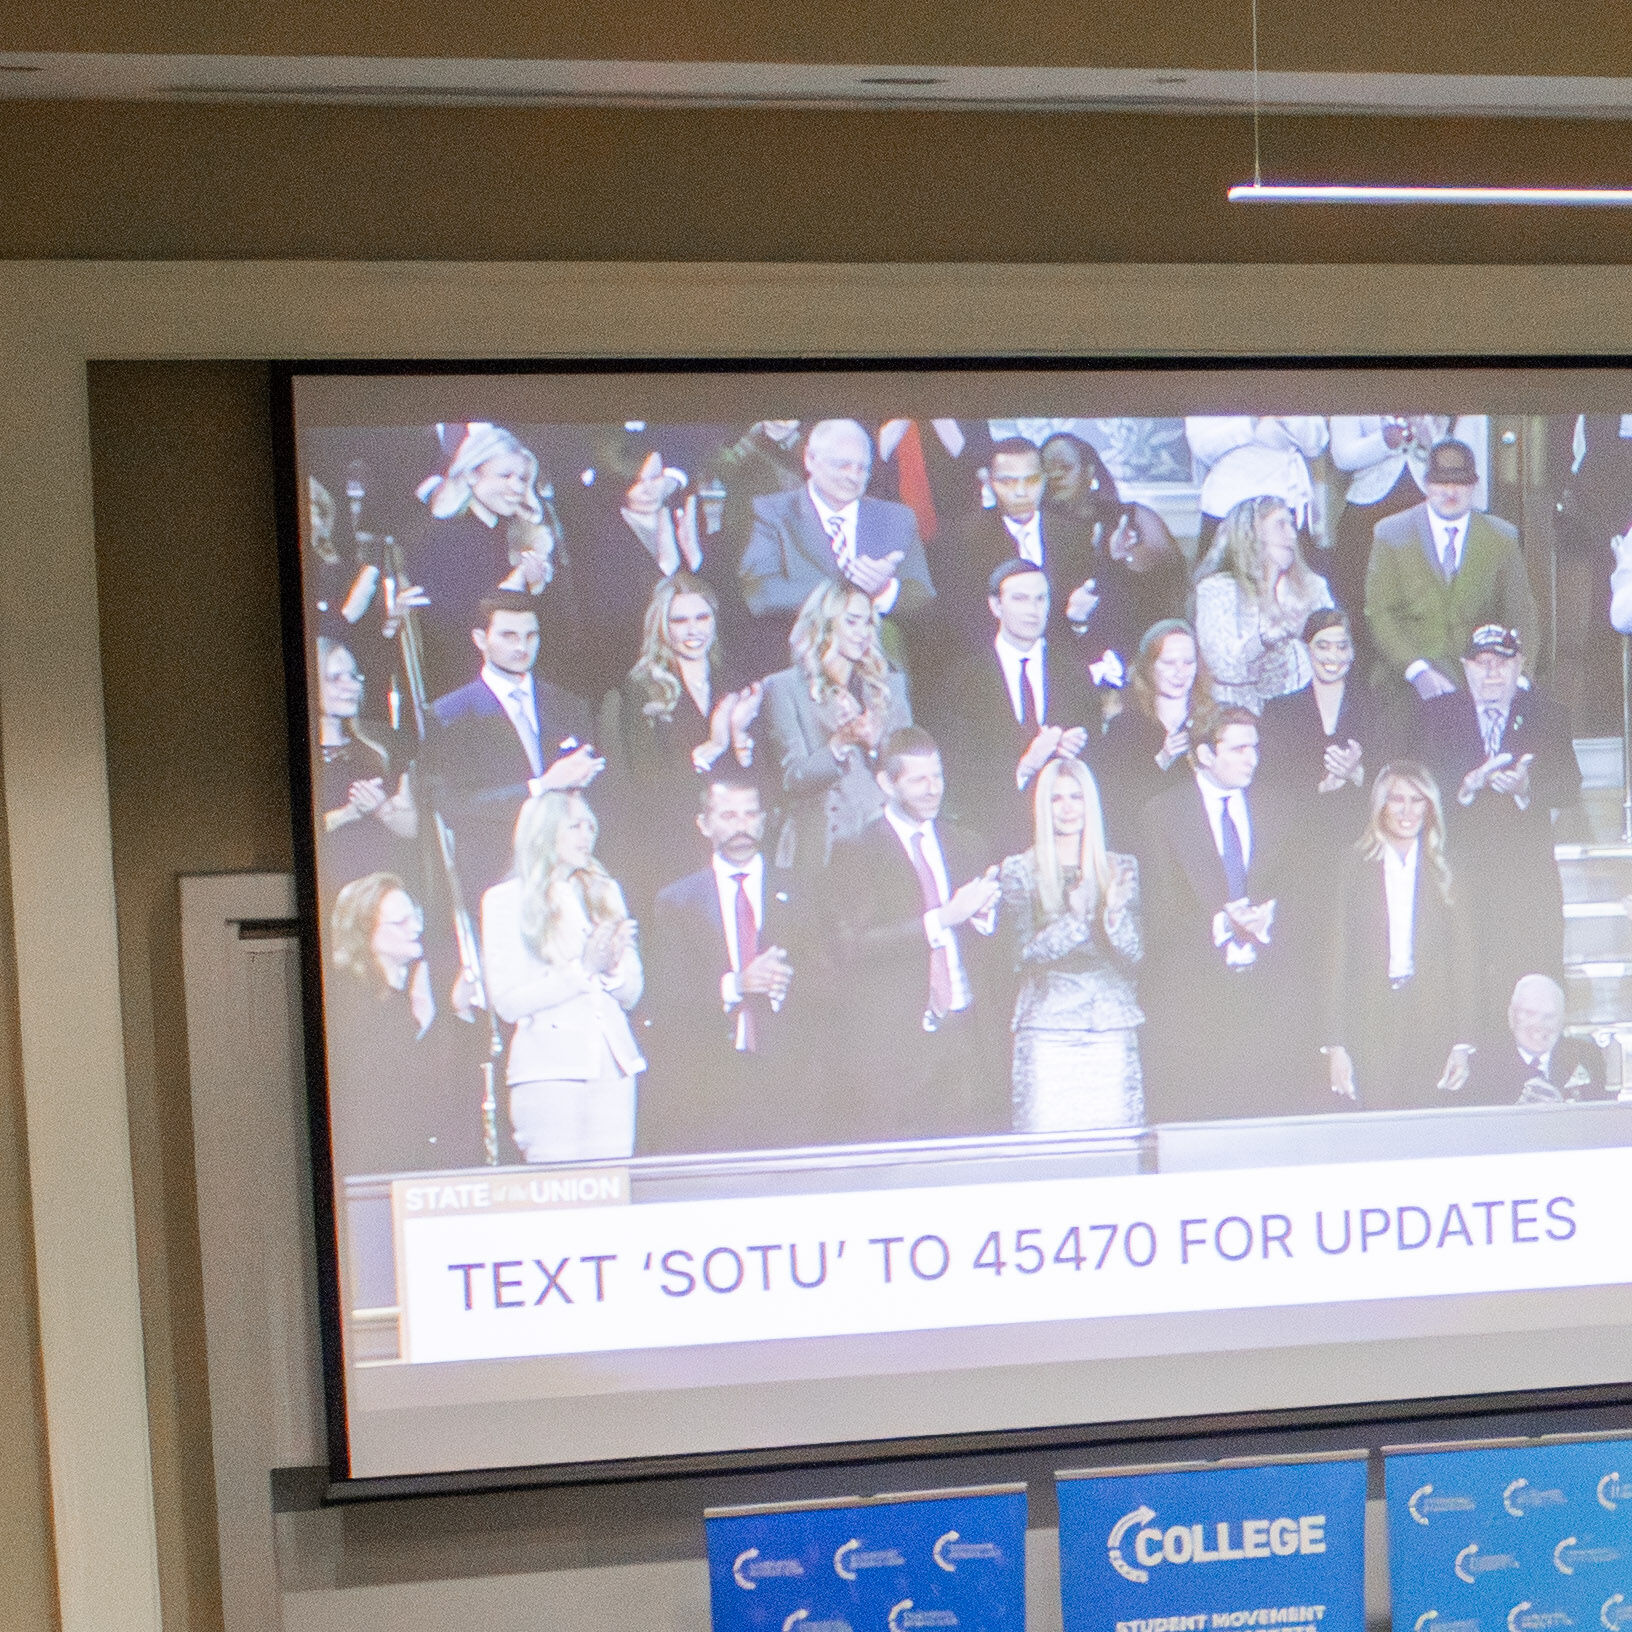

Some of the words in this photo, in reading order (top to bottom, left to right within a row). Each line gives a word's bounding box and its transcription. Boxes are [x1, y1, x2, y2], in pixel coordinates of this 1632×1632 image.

[405, 1183, 492, 1211] STATE
[530, 1175, 620, 1204] UNION
[447, 1253, 619, 1312] TEXT
[868, 1233, 951, 1285] TO
[973, 1220, 1158, 1278] 45470
[1179, 1213, 1294, 1266] FOR
[1314, 1196, 1578, 1256] UPDATES
[1135, 1514, 1327, 1567] COLLEGE
[1211, 1605, 1327, 1628] MOVEMENT
